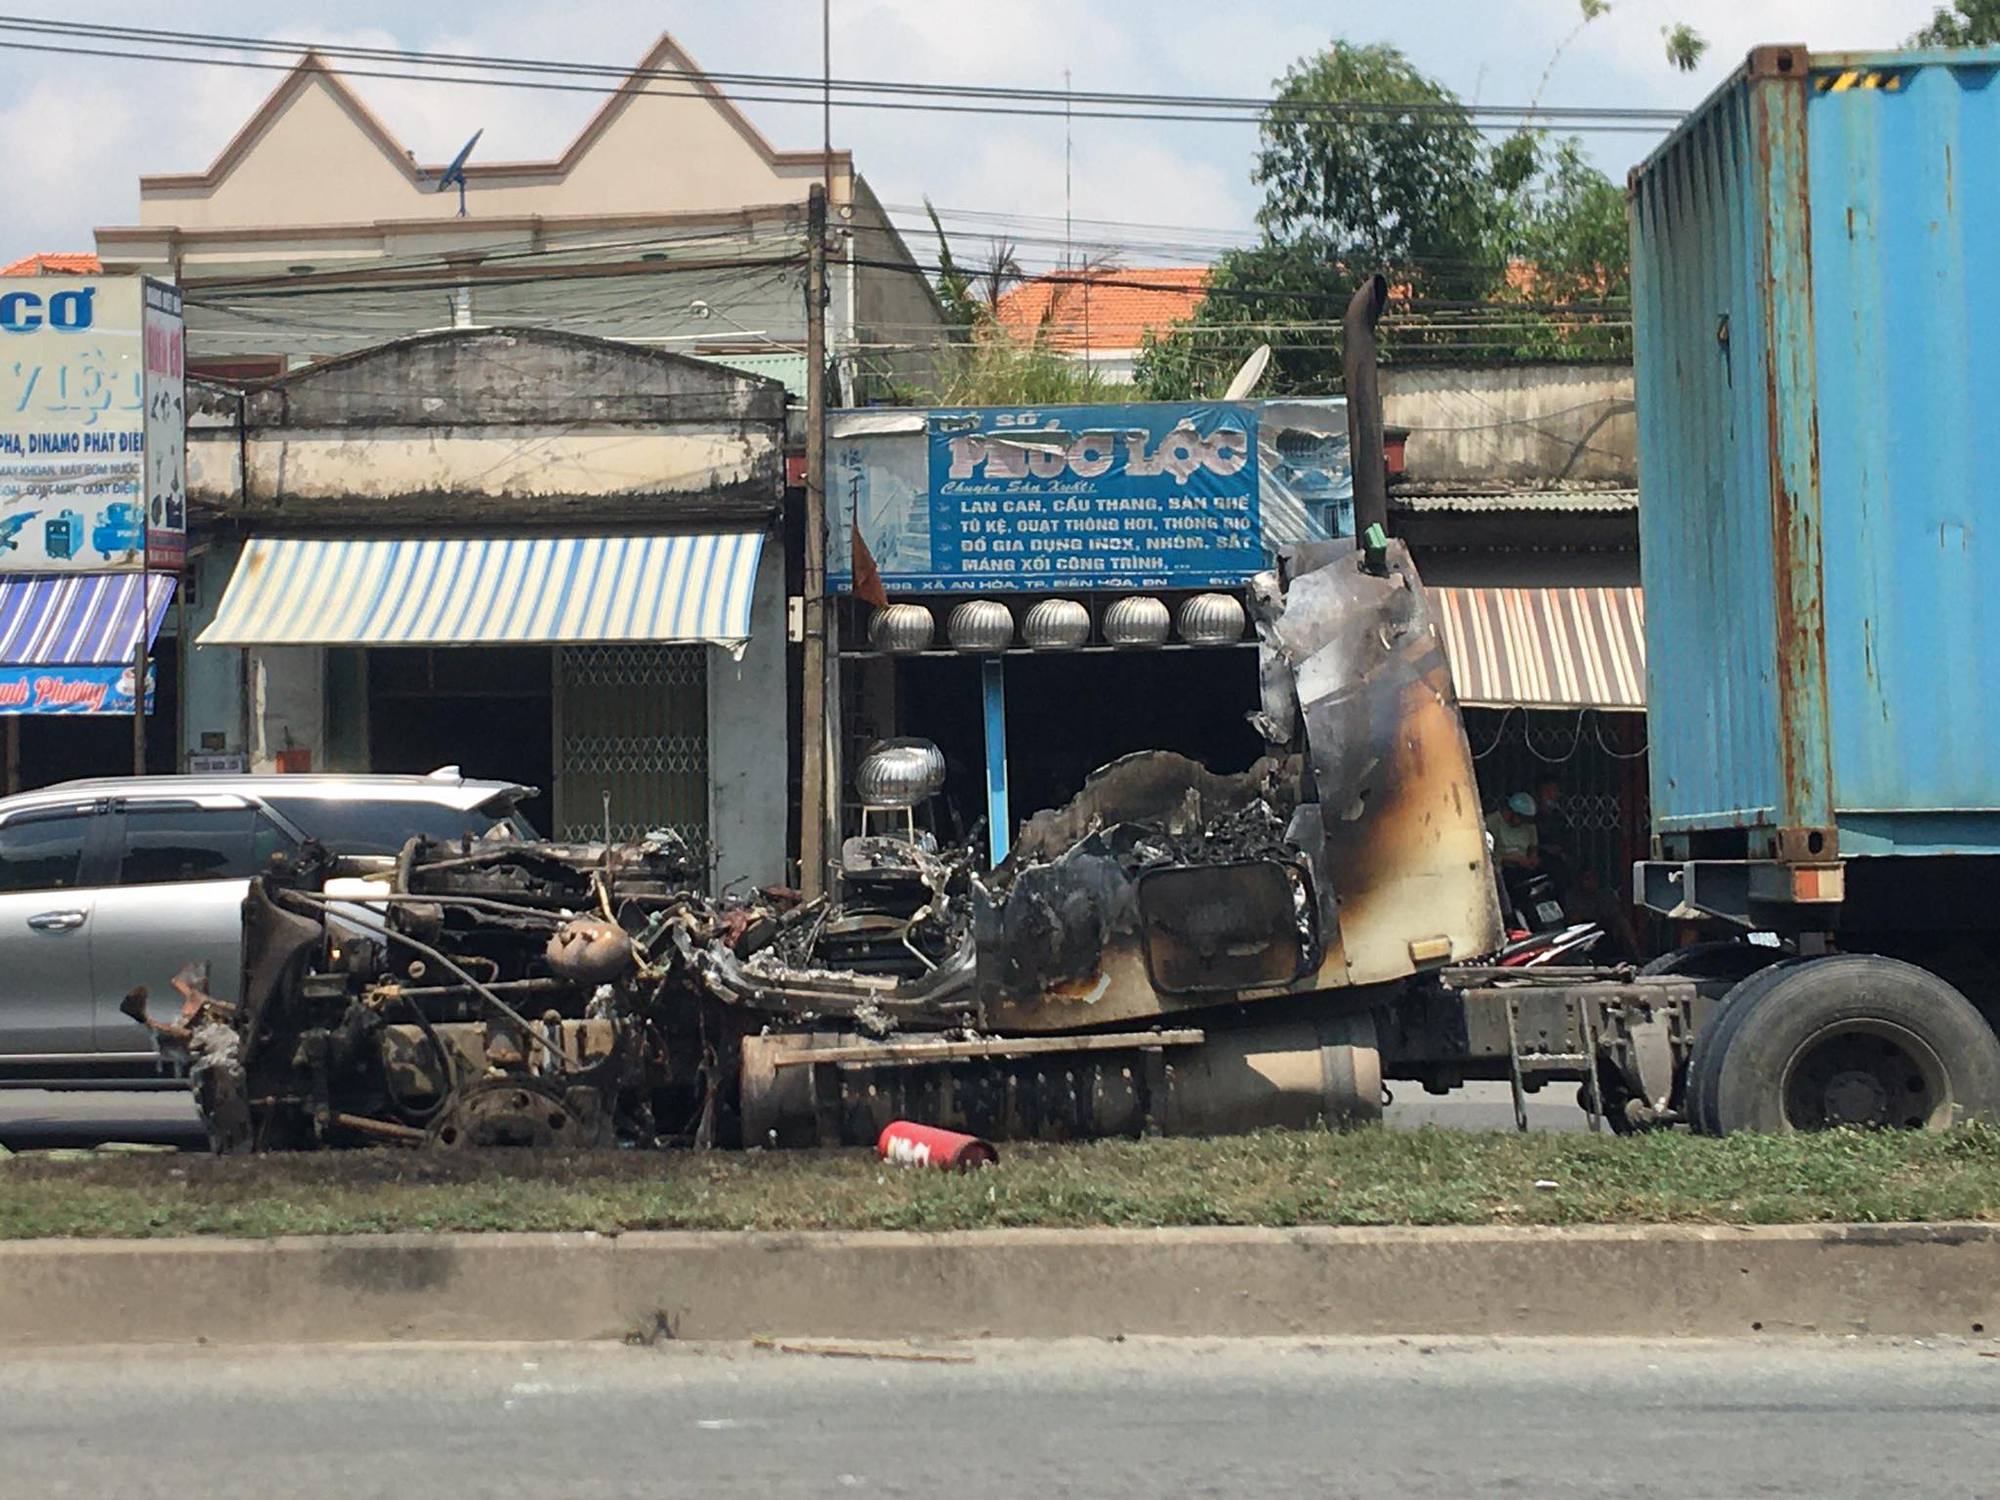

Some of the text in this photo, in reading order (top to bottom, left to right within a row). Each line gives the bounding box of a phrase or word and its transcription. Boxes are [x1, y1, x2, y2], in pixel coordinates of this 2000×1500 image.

[0, 286, 96, 334] CƠ
[28, 432, 80, 453] DINAMO
[1124, 418, 1248, 485] LỘC
[961, 501, 997, 513] LAN
[1003, 501, 1047, 514] CAN,
[1096, 499, 1163, 512] THANG,
[1065, 516, 1119, 532] THÔNG
[992, 540, 1024, 551] GIA
[1030, 538, 1083, 553] DỤNG
[1089, 538, 1140, 551] INOX,
[962, 557, 1015, 572] MÁNG
[1056, 555, 1105, 571] CÔNG
[951, 581, 975, 590] AN
